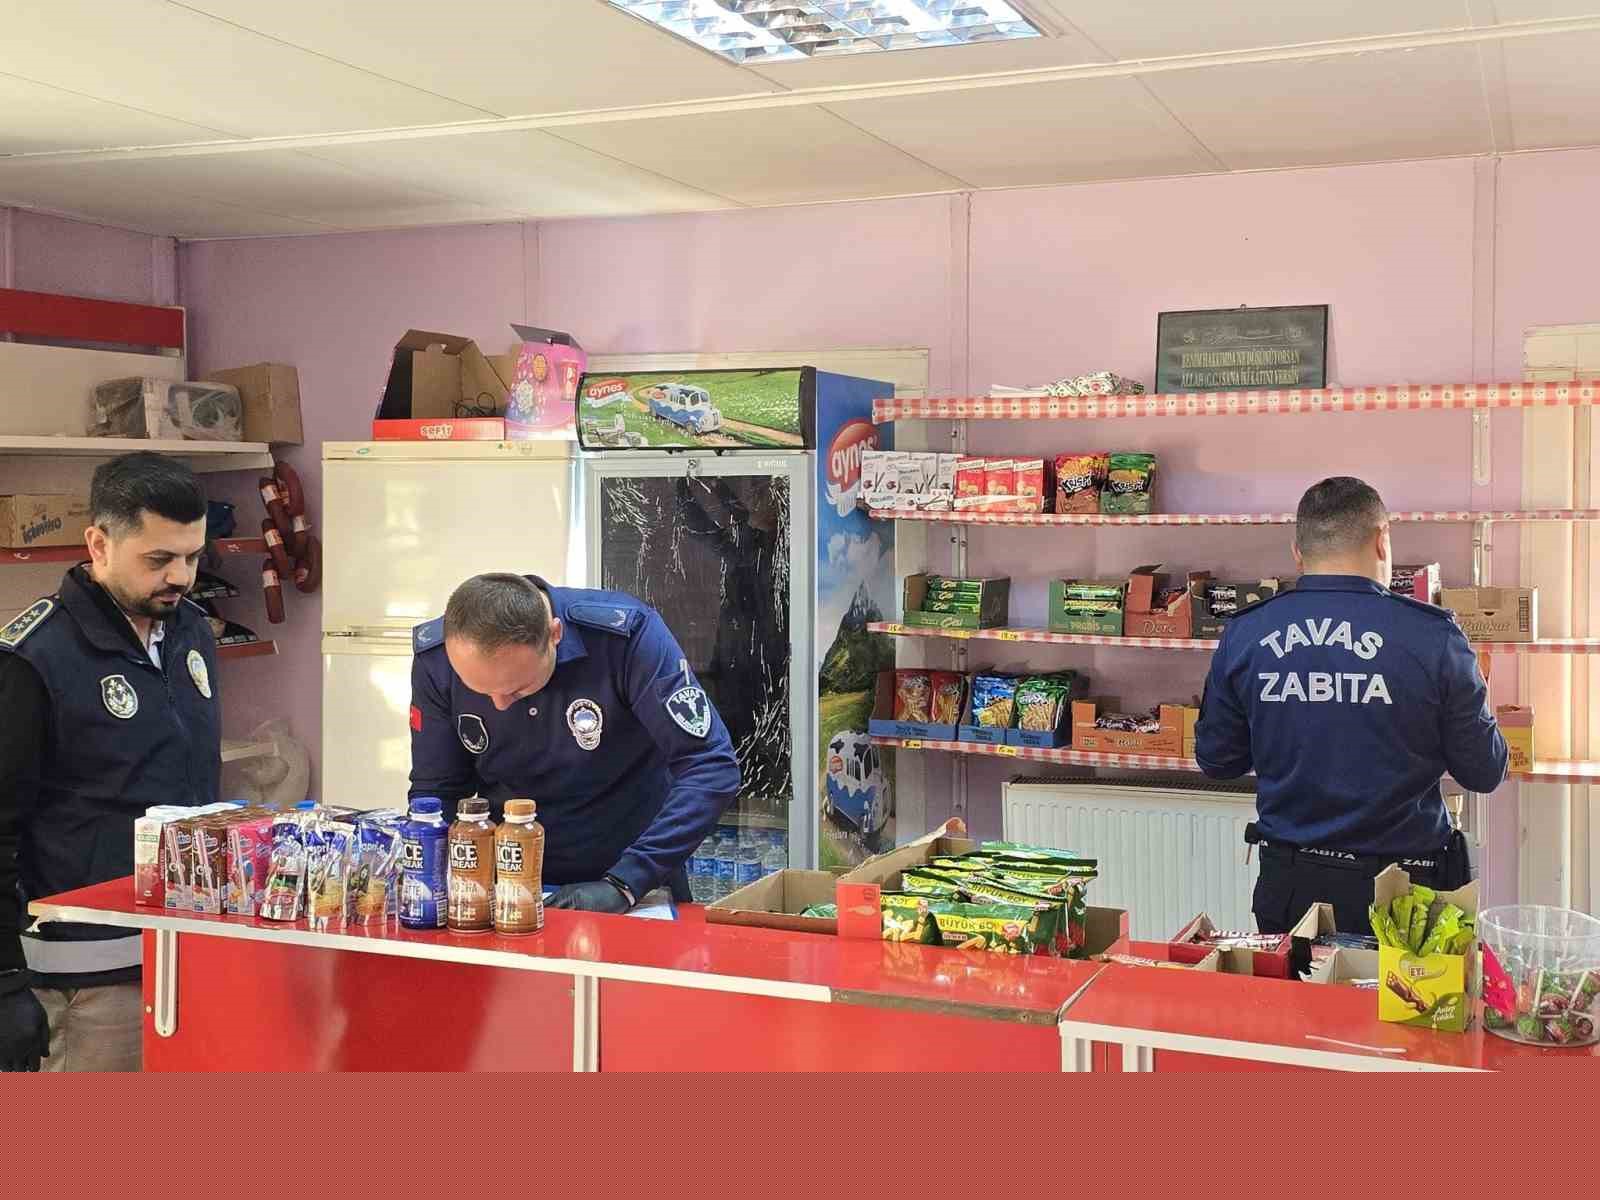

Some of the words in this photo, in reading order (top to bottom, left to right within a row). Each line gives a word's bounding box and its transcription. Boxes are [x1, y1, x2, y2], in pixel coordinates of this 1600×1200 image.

[589, 384, 624, 398] aynes
[1259, 618, 1384, 660] TAVAS
[1258, 672, 1393, 704] ZABITA
[403, 844, 423, 860] CE
[450, 844, 477, 861] ICE
[497, 846, 522, 863] ICE
[1402, 858, 1435, 868] ZABI
[938, 918, 976, 930] BÜYÜK
